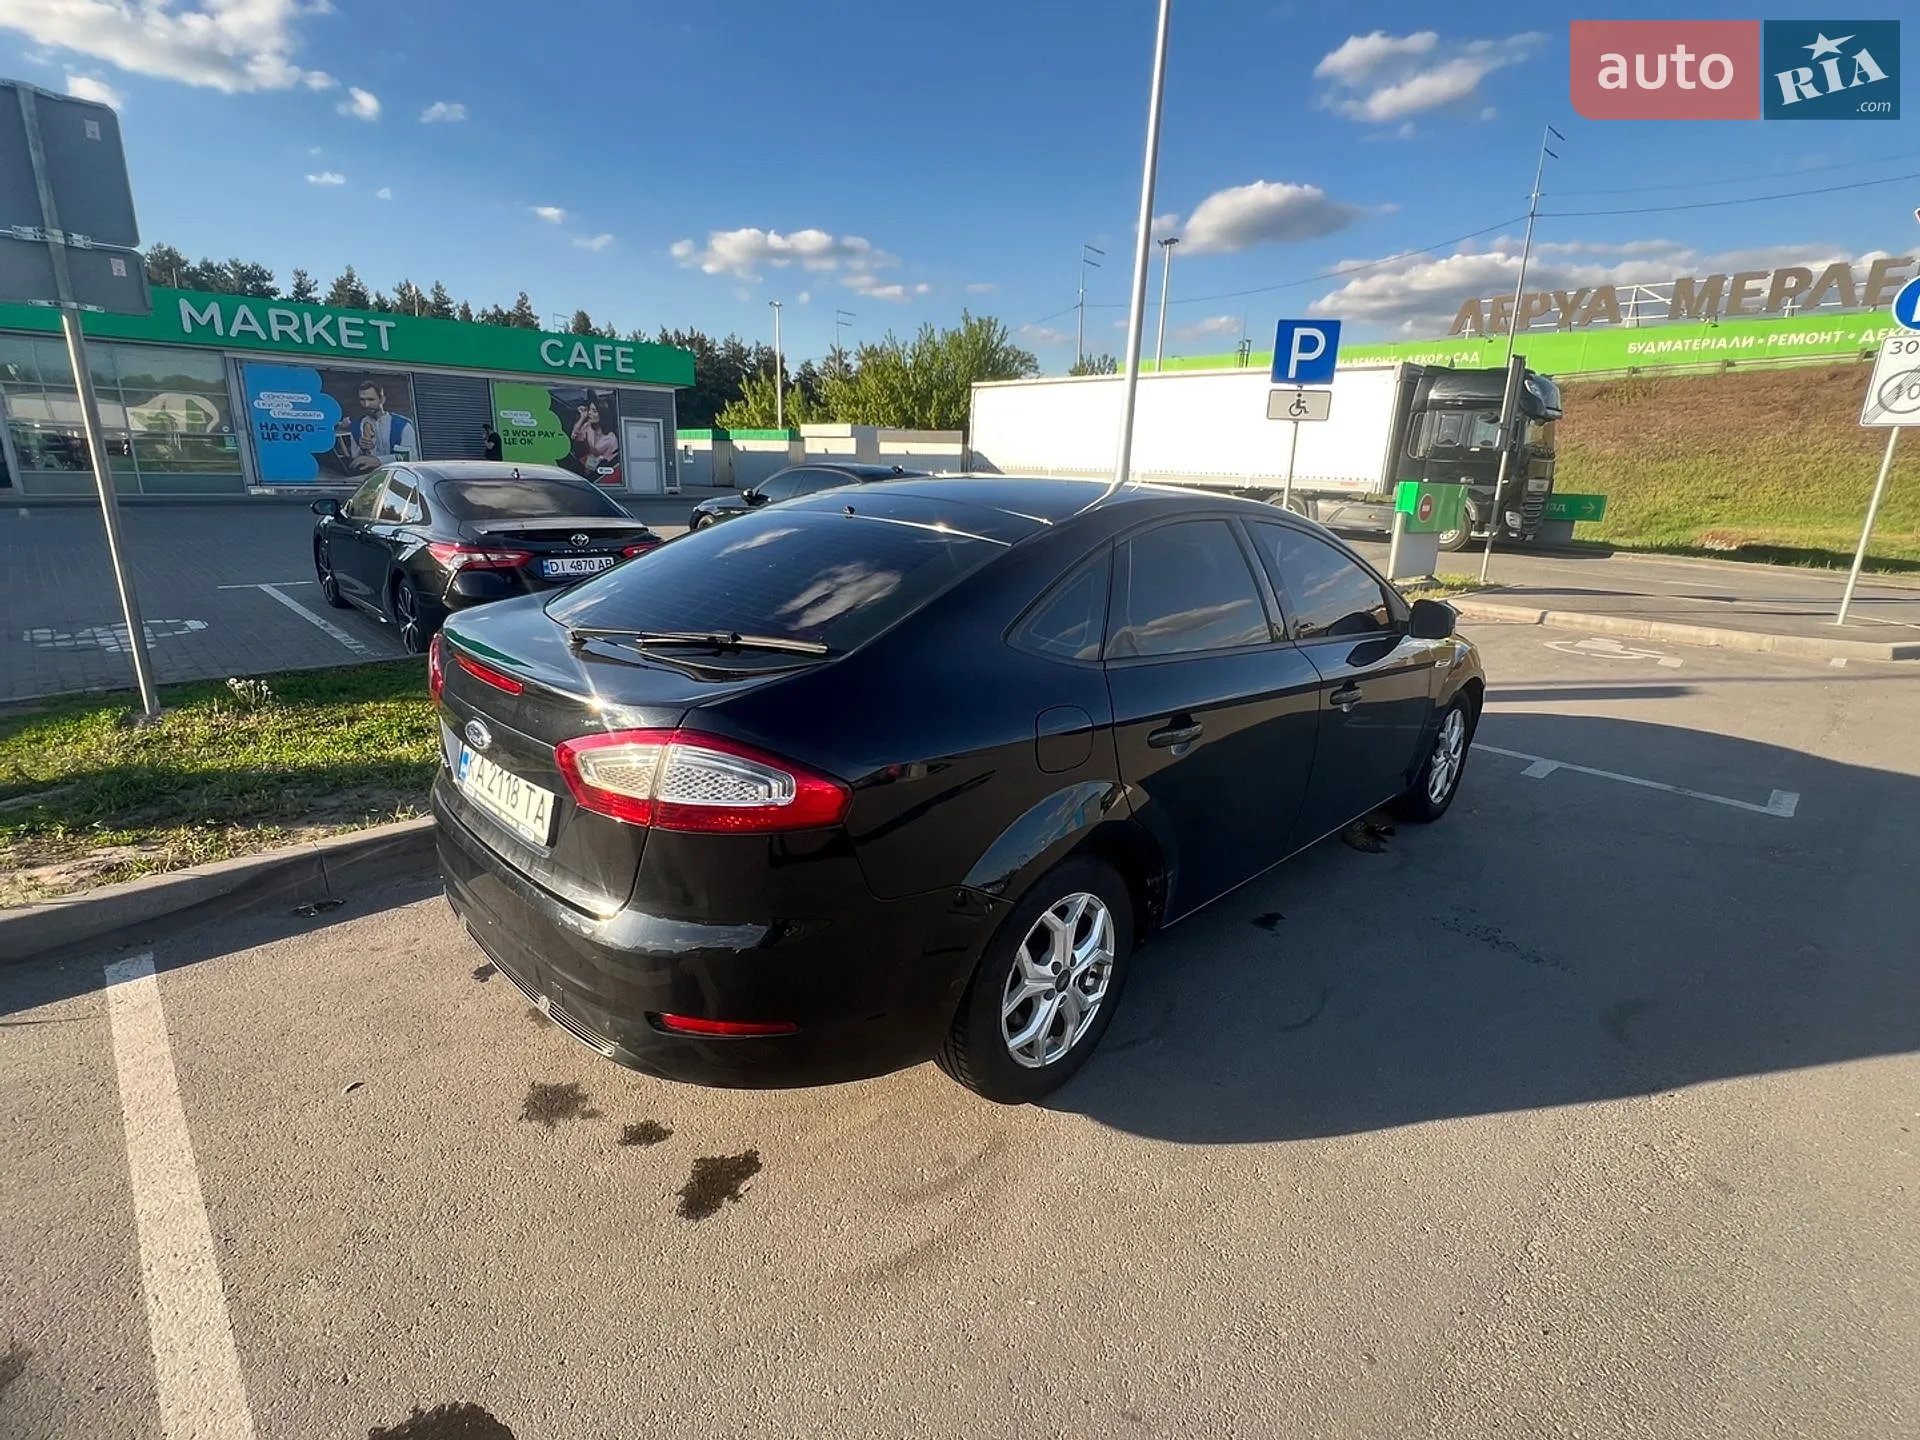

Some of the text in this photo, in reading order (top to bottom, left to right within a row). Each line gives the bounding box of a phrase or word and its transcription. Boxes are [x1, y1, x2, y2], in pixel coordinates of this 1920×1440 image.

[1447, 256, 1916, 336] ЛЕРУА МЕРЛЕ
[178, 298, 637, 374] MARKET CAFE
[1627, 335, 1753, 354] БУДМАТЕРІАЛИ
[1767, 330, 1844, 346] РЕМОНТ
[1287, 327, 1327, 379] P
[1889, 340, 1920, 355] 30
[1407, 354, 1443, 365] ДЕКОР
[1453, 351, 1481, 364] САД
[259, 422, 280, 432] НА
[282, 422, 315, 432] WOG
[261, 432, 280, 442] ЦЕ
[570, 559, 595, 571] 4870
[487, 762, 520, 810] 2118
[525, 783, 546, 830] TA
